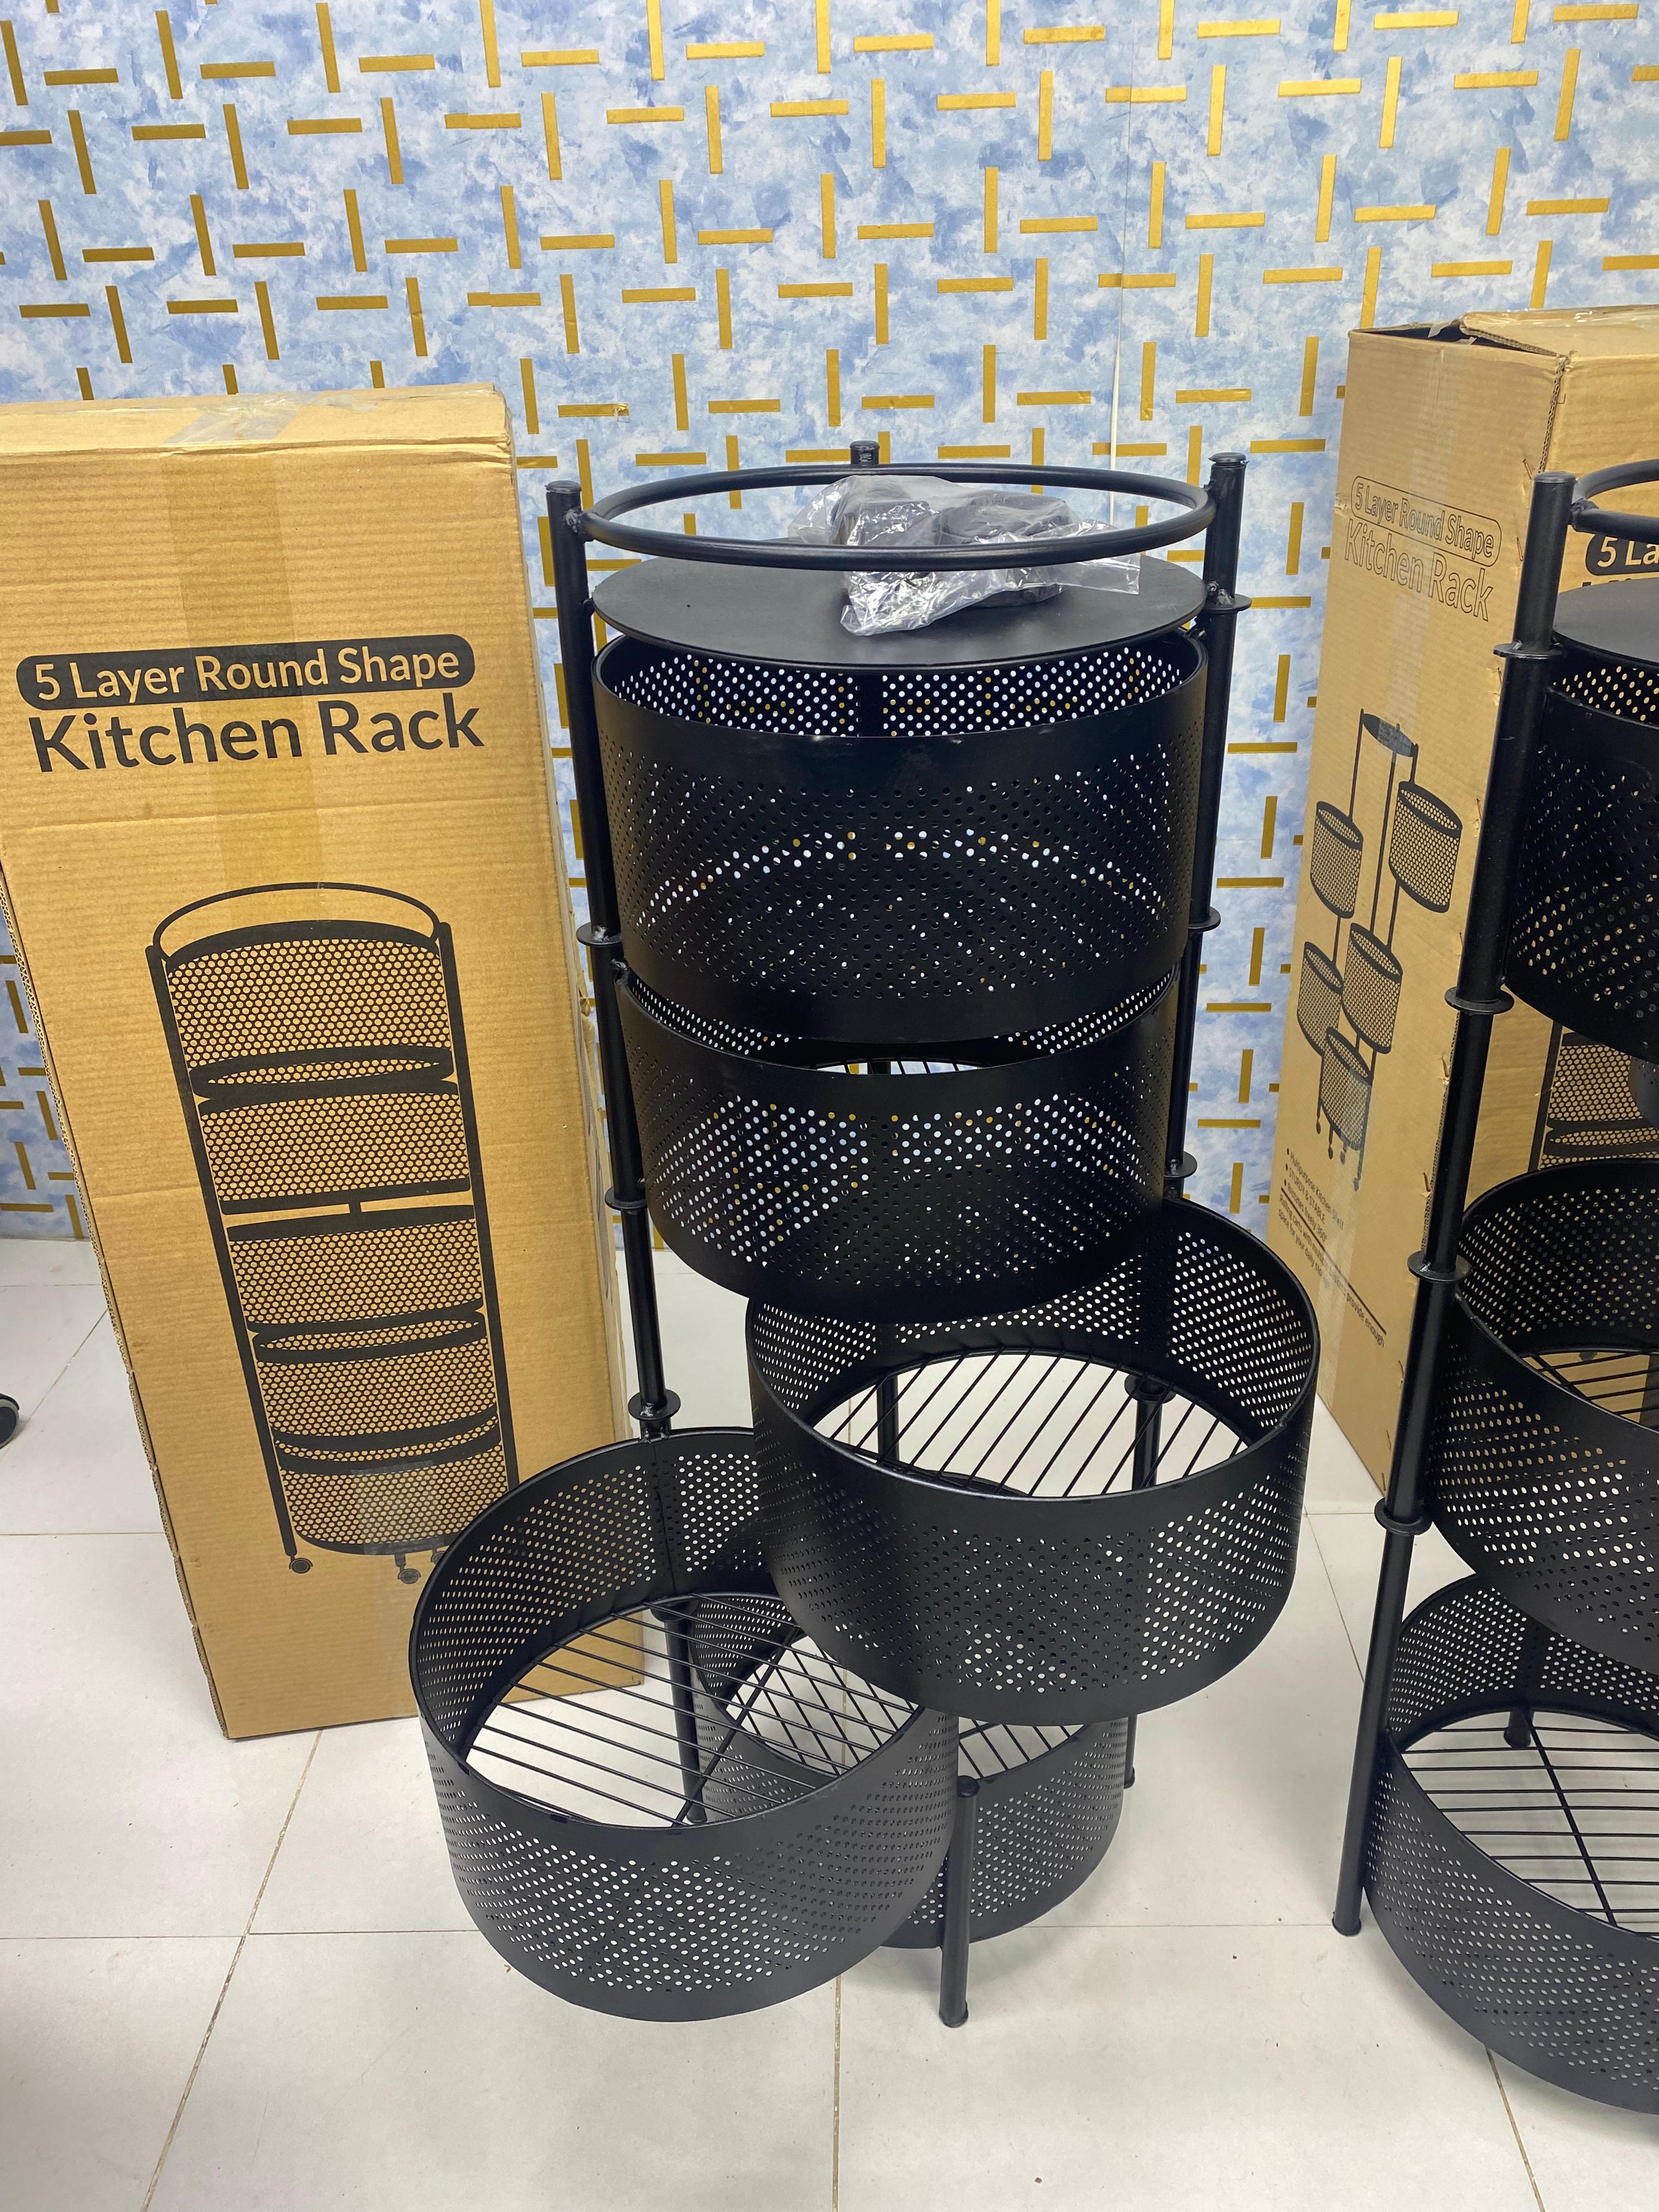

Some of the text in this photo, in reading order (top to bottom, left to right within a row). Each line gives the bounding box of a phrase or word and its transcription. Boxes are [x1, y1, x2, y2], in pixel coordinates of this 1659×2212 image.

[1356, 483, 1495, 563] 5 Layer Round Shape
[1597, 536, 1618, 568] 5
[1344, 518, 1494, 622] Kitchen Rack
[35, 645, 461, 704] 5 Layer Round Shape
[28, 692, 486, 772] Kitchen Rack
[1289, 1167, 1305, 1195] STURDY
[1308, 1195, 1325, 1225] STABLE
[1290, 1152, 1315, 1193] Multipurpose
[1316, 1186, 1331, 1214] Kitchen
[1346, 1292, 1365, 1322] provide
[1364, 1318, 1385, 1347] enough
